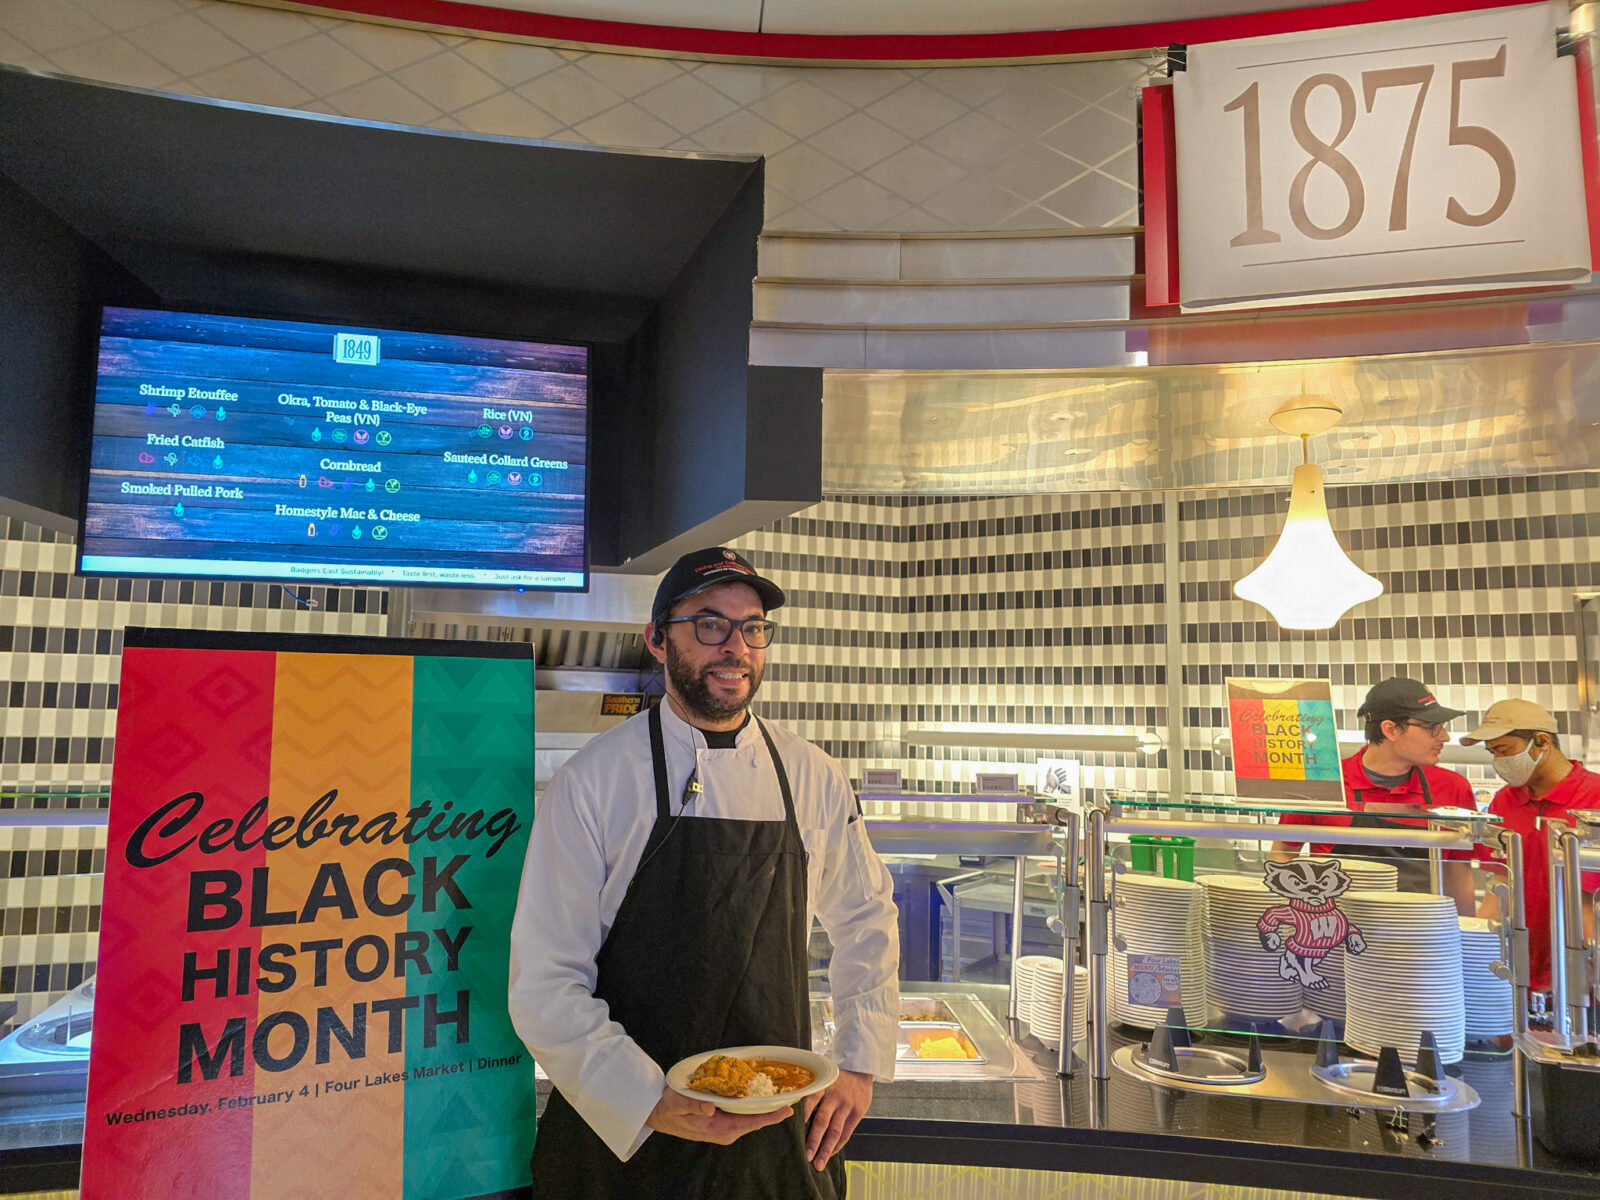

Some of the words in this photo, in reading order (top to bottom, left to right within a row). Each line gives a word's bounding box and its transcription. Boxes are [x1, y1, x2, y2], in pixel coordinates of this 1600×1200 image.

[1223, 44, 1517, 247] 1875
[342, 338, 372, 360] 1849
[139, 384, 185, 400] Shrimp
[188, 387, 238, 401] Etouffee
[278, 393, 310, 408] Okra,
[313, 396, 357, 410] Tomato
[359, 399, 369, 410] &
[371, 400, 427, 416] Black-Eye
[325, 411, 351, 424] Peas
[353, 413, 380, 427] (VN)
[483, 408, 507, 420] Rice
[508, 409, 533, 423] (VN)
[146, 433, 179, 446] Fried
[181, 435, 225, 449] Catfish
[320, 458, 381, 472] Cornbread
[444, 451, 487, 464] Sauteed
[489, 454, 529, 467] Collard
[530, 457, 568, 469] Greens
[121, 482, 172, 495] Smoked
[174, 484, 212, 497] Pulled
[214, 487, 244, 499] Pork
[275, 504, 338, 520] Homestyle
[340, 507, 366, 519] Mac
[367, 508, 378, 520] &
[379, 509, 421, 522] Cheese
[290, 566, 320, 575] Badgers
[606, 695, 640, 703] Southern
[604, 703, 639, 714] PRIDE
[1239, 709, 1324, 727] Celebrating
[1251, 723, 1313, 737] BLACK
[1252, 737, 1314, 750] HISTORY
[1254, 751, 1318, 765] MONTH
[125, 789, 521, 868] Celebrating
[186, 854, 473, 932] BLACK
[1310, 915, 1338, 941] W
[181, 926, 473, 1002] HISTORY
[176, 990, 471, 1085] MONTH
[106, 1103, 213, 1126] Wednesday,
[217, 1090, 294, 1111] February
[298, 1085, 309, 1097] 4
[325, 1079, 360, 1094] Four
[365, 1070, 409, 1087] Lakes
[413, 1061, 464, 1079] Market
[477, 1053, 523, 1070] Dinner
